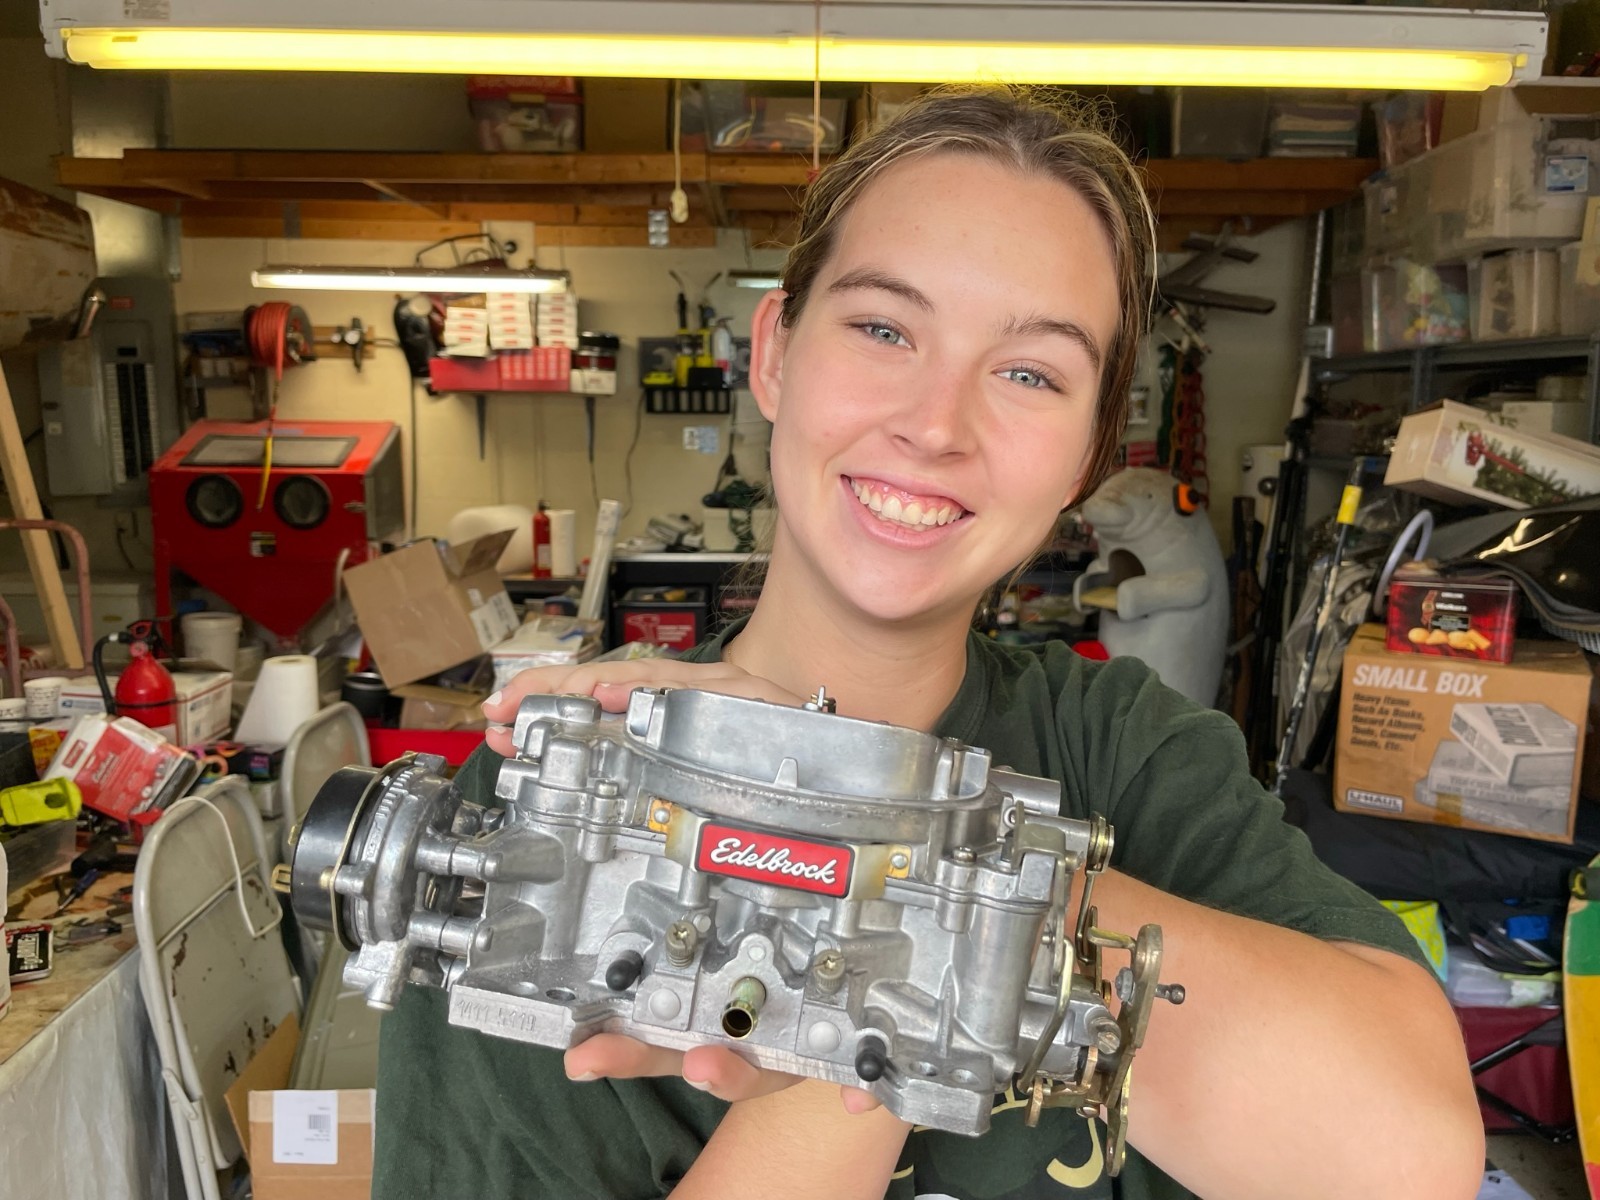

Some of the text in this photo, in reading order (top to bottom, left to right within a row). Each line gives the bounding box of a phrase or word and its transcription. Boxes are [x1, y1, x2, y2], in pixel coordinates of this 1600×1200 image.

[1353, 664, 1488, 698] SMALL BOX
[710, 837, 838, 884] Edelbrock
